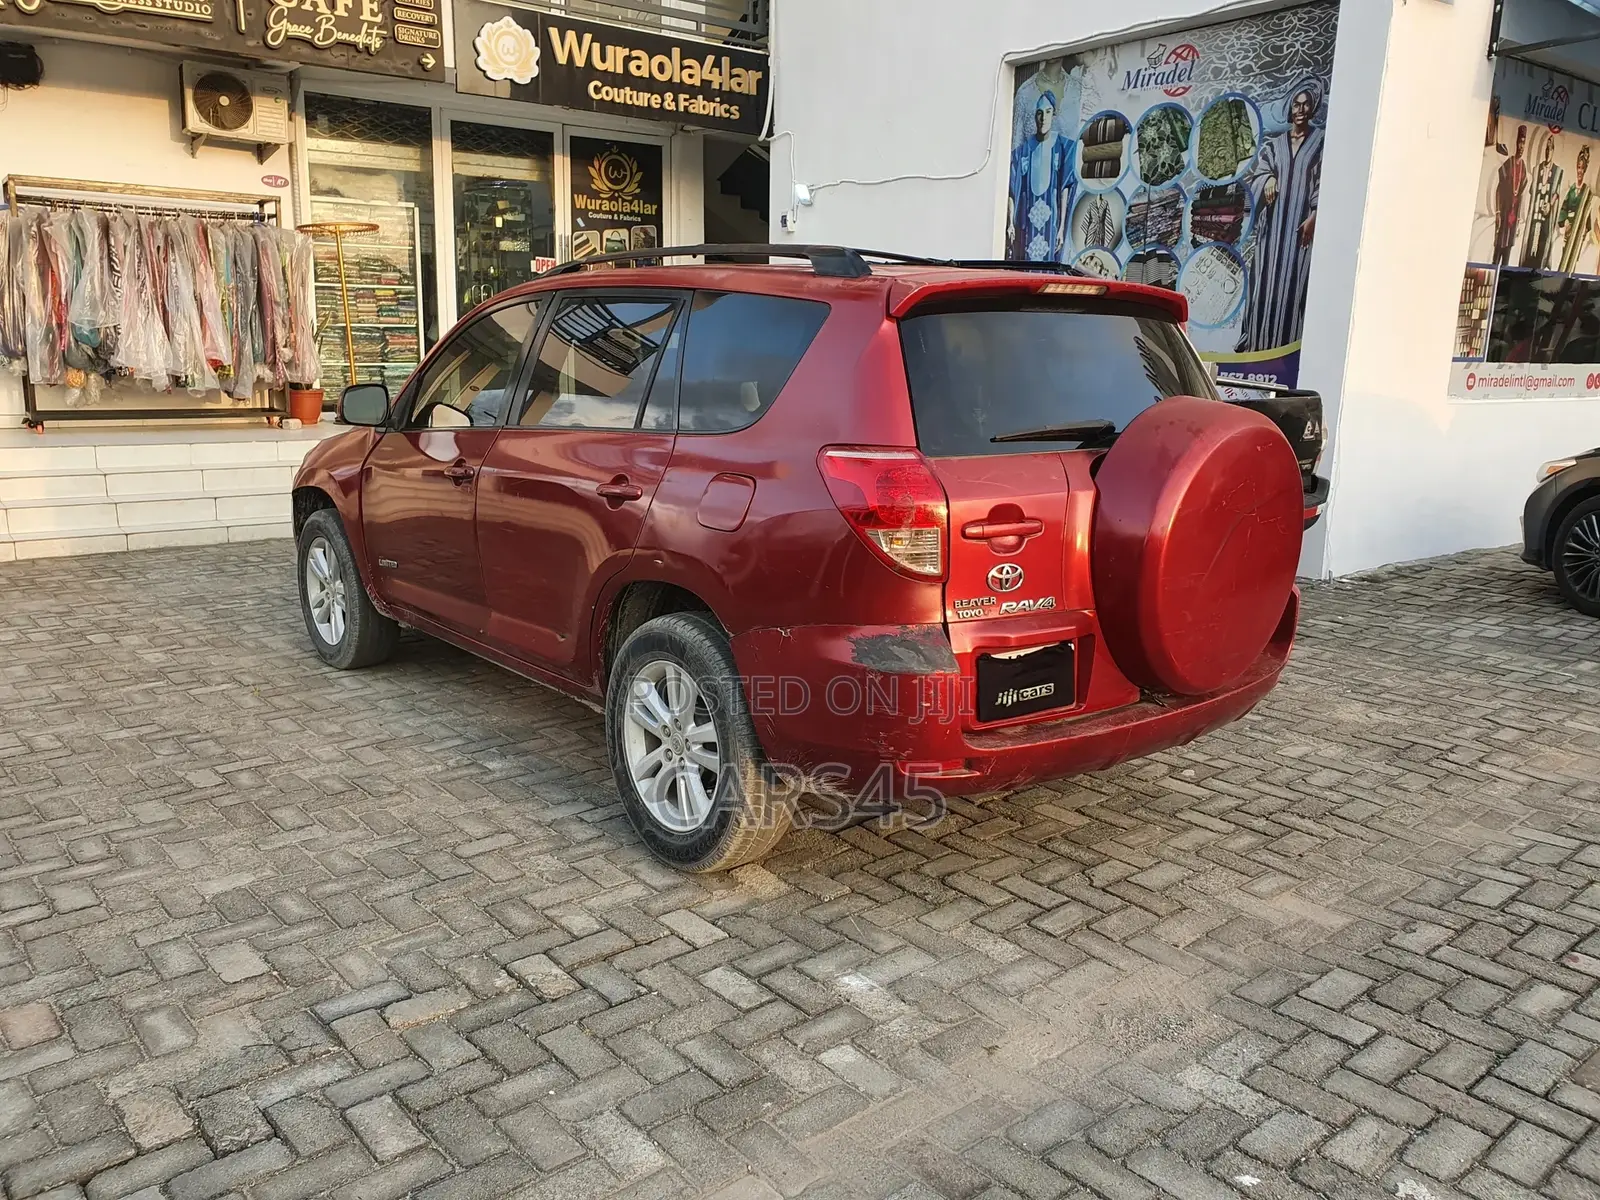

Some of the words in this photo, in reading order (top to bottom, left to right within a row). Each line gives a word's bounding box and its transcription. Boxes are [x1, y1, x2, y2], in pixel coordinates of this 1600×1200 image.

[155, 0, 212, 14] STUDIO
[396, 10, 434, 23] RECOVERY
[266, 6, 314, 46] Grace
[313, 14, 388, 52] Benedicts
[397, 26, 438, 40] SIGNATURE
[398, 33, 425, 44] DRINKS
[548, 26, 763, 96] Wuraola4lar
[1121, 58, 1196, 91] Miradel
[587, 80, 663, 110] Couture
[664, 91, 677, 112] &
[678, 93, 741, 121] Fabrics
[1523, 92, 1568, 123] Miradel
[573, 193, 658, 216] Wuraola4lar
[588, 211, 613, 221] Couture
[614, 213, 619, 221] &
[619, 213, 642, 223] Fabrics
[1477, 373, 1576, 392] miradelintl@gmail.com
[954, 596, 997, 609] BEAVER
[999, 596, 1057, 615] RAV4
[1020, 683, 1055, 701] cars
